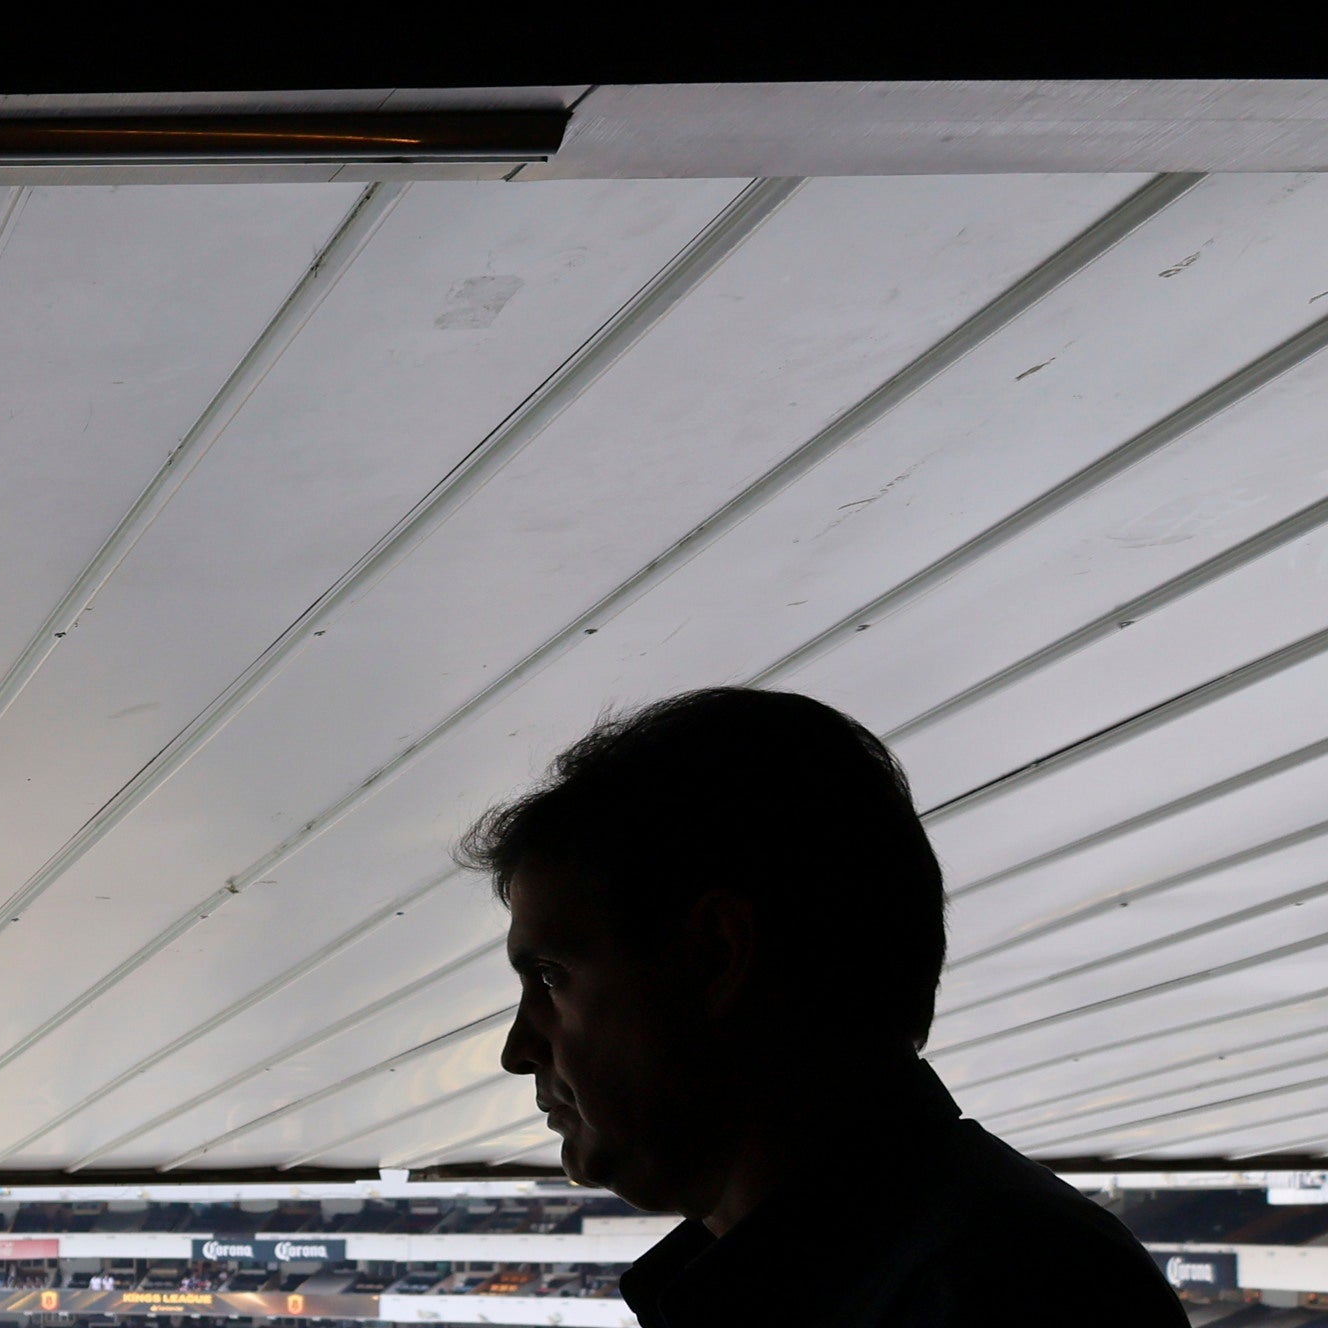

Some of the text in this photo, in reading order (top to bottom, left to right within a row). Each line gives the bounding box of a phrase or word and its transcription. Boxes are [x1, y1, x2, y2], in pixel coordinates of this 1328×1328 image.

[202, 1240, 254, 1261] Corona
[274, 1242, 328, 1262] Corona
[1166, 1256, 1214, 1287] Corona
[123, 1292, 212, 1305] KINGS LEAGUE
